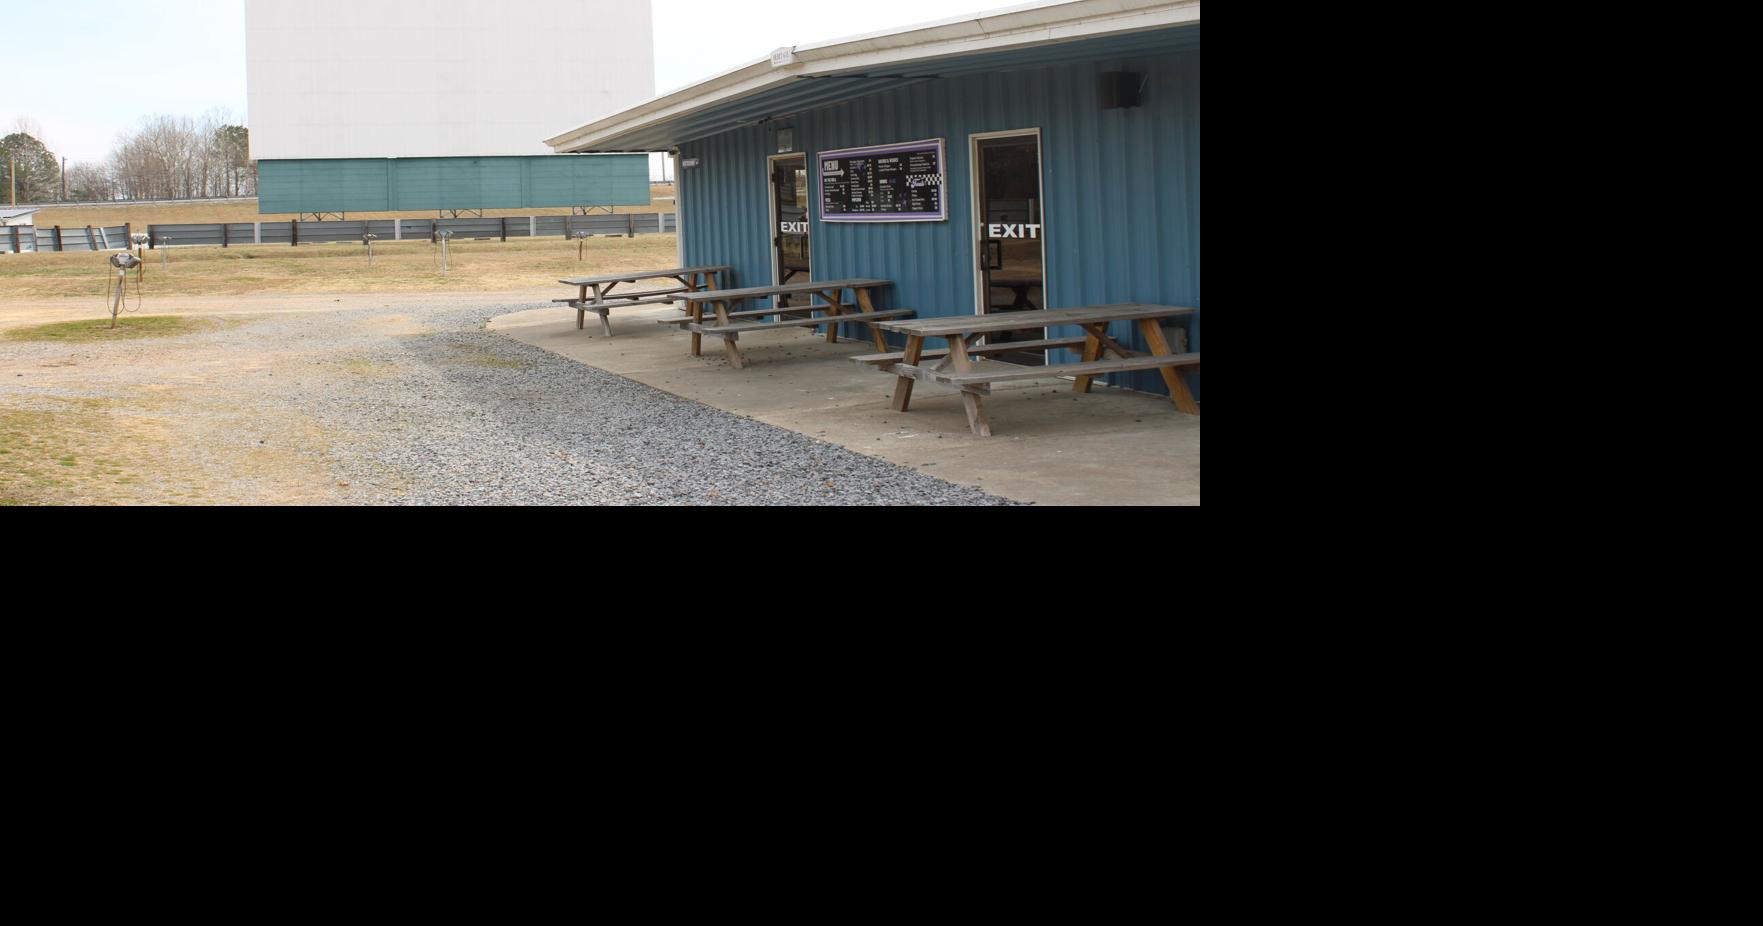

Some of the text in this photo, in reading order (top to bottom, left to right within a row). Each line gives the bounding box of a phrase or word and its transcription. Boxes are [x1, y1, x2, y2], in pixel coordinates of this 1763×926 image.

[824, 160, 838, 171] MENU
[780, 221, 808, 233] EXIT
[988, 223, 1041, 239] EXIT
